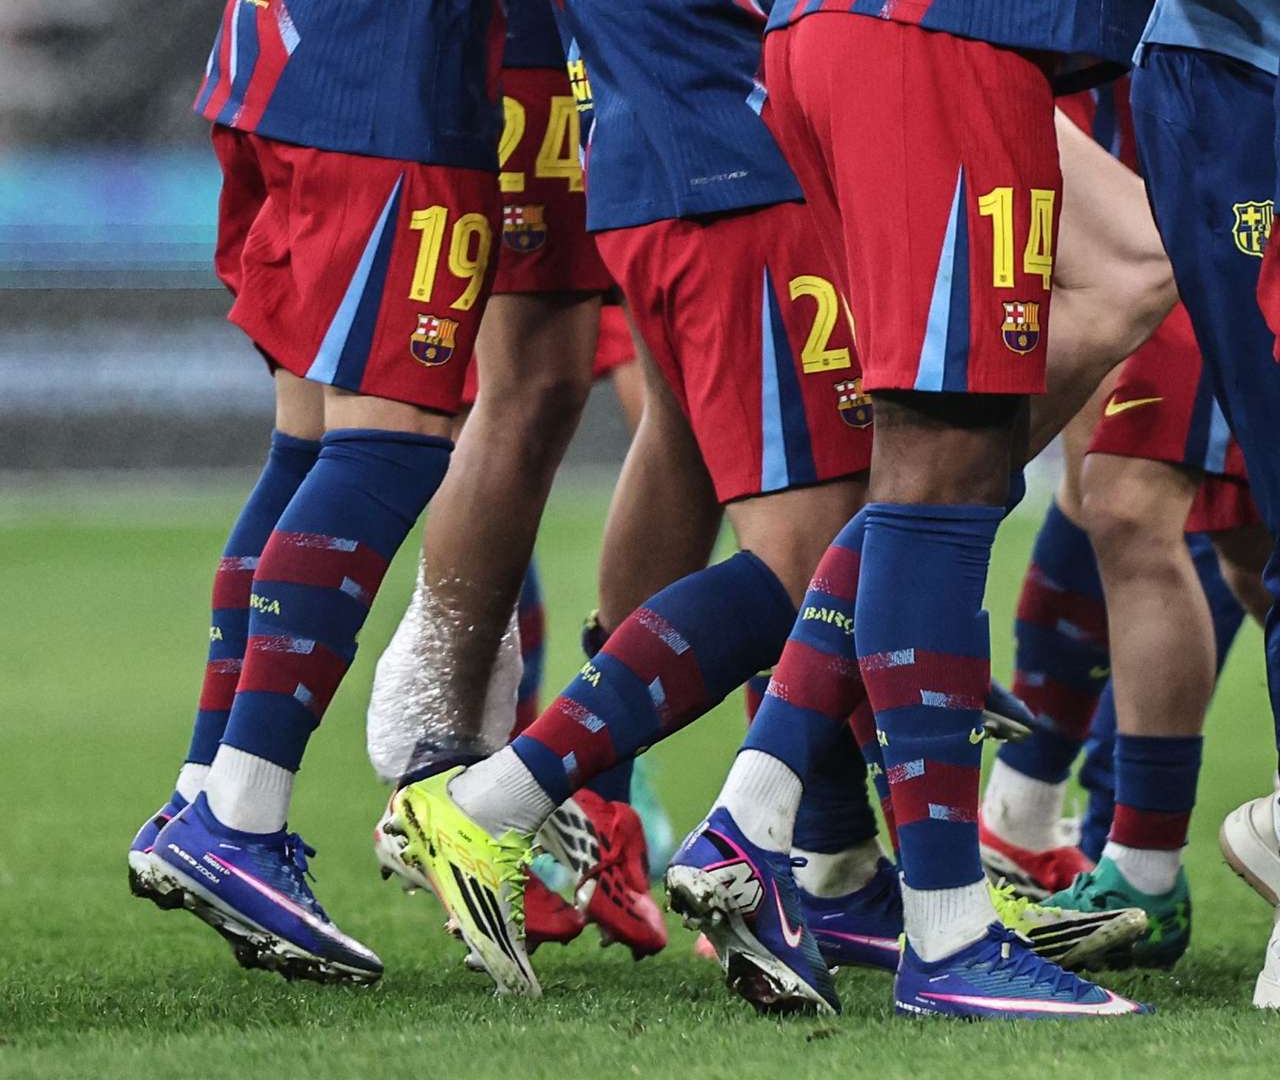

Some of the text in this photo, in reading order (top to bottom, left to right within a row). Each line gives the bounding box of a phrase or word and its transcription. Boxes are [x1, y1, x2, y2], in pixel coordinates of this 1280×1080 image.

[497, 96, 586, 192] 24
[408, 205, 493, 311] 19
[978, 187, 1056, 291] 14
[789, 275, 857, 374] 2
[250, 593, 281, 615] RÇA
[803, 607, 856, 635] BARÇ
